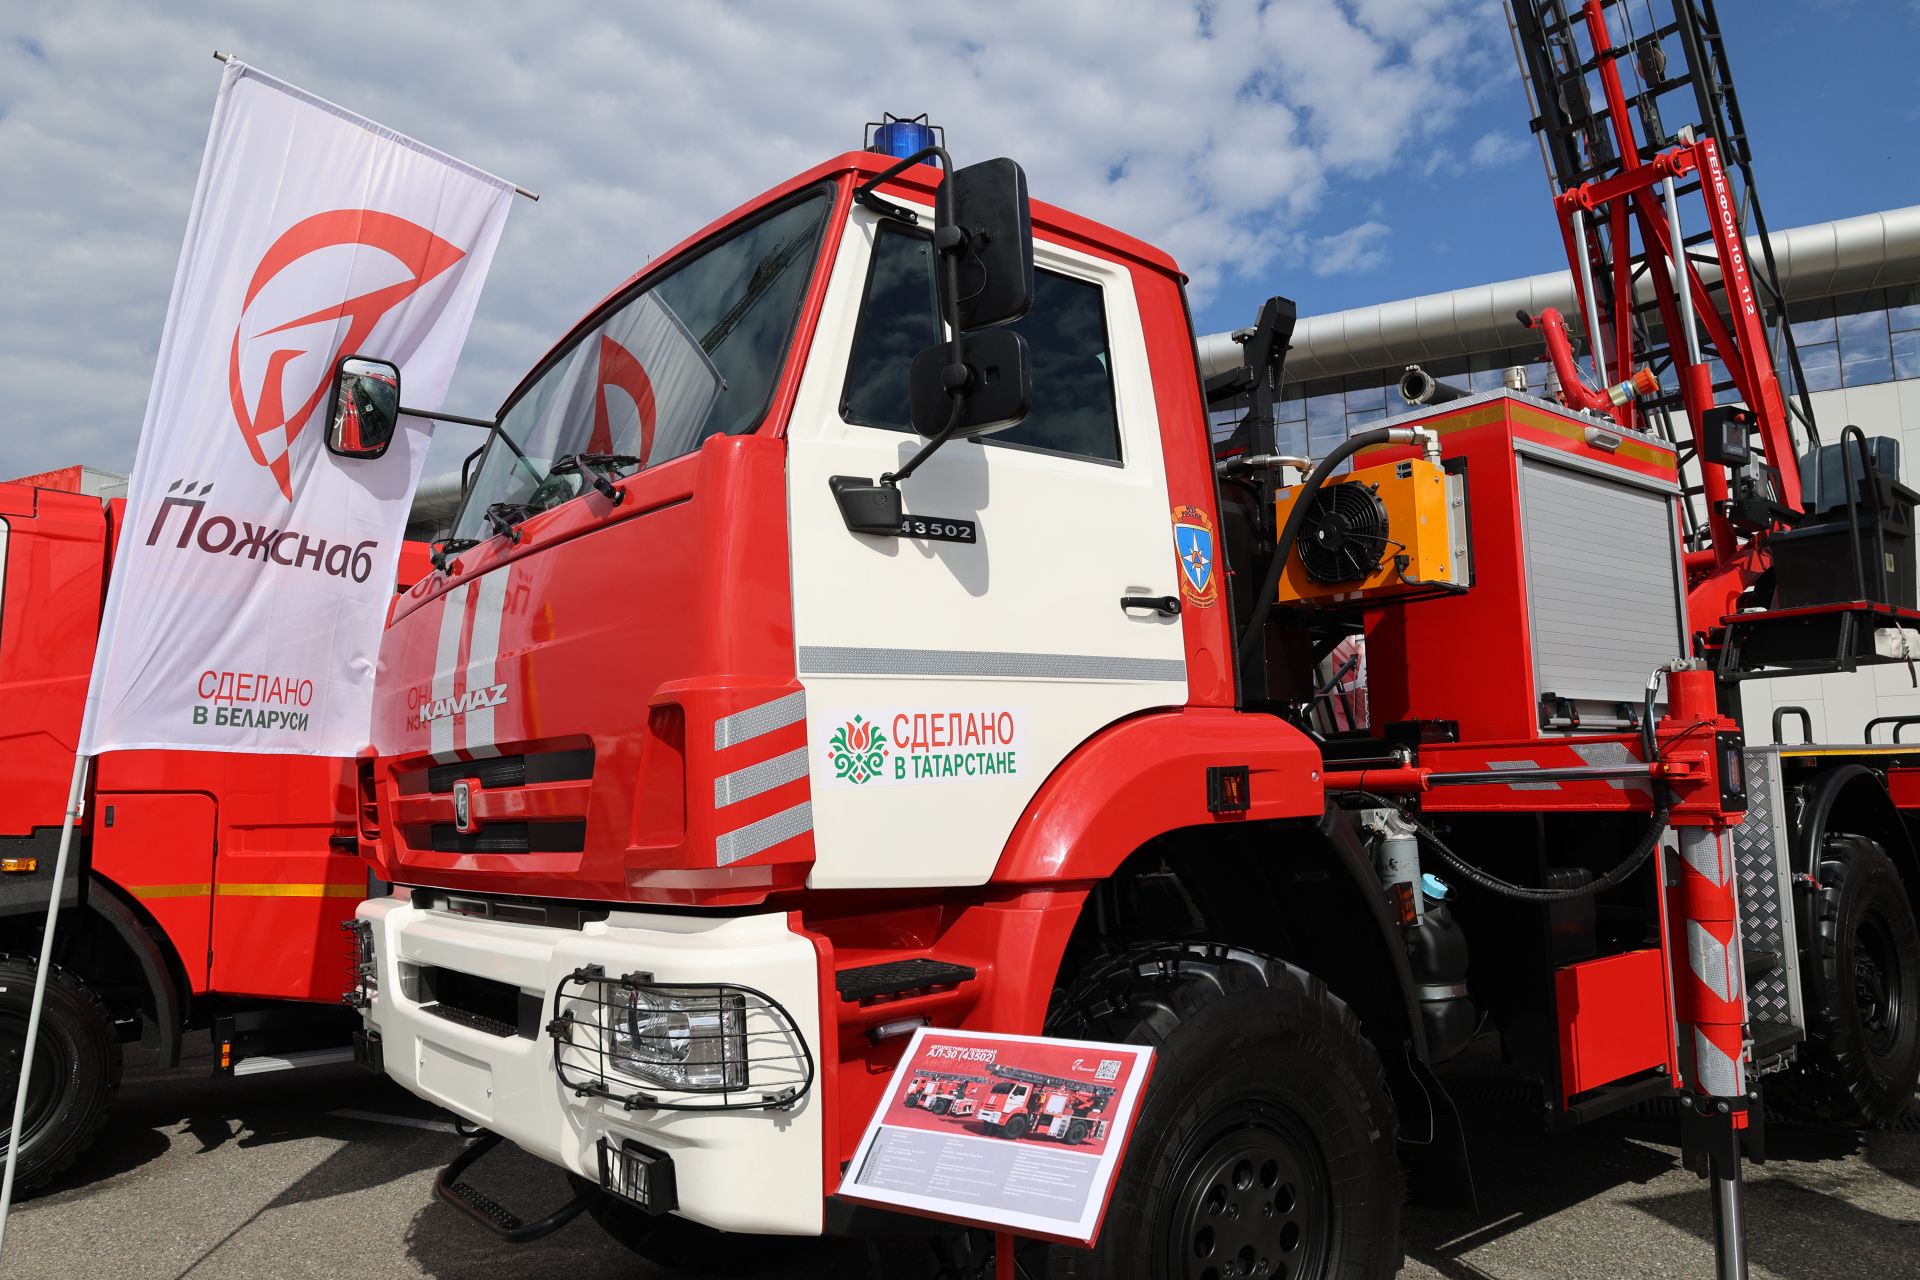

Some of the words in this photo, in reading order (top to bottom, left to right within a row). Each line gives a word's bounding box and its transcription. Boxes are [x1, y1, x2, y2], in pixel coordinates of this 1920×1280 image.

[1707, 143, 1735, 239] ТЕЛЕФОН
[1742, 285, 1755, 316] 112
[146, 478, 378, 583] Пожснаб
[902, 520, 971, 538] 43502
[197, 670, 313, 707] СДЕЛАНО
[419, 683, 508, 723] KAMAZ
[192, 705, 208, 725] В
[215, 706, 309, 731] БЕЛАРУСИ
[892, 711, 1014, 753] СДЕЛАНО
[895, 756, 906, 779] В
[911, 751, 1016, 778] ТАТАРСТАНЕ
[926, 1048, 957, 1058] АЛ-30
[958, 1049, 995, 1064] (43502)
